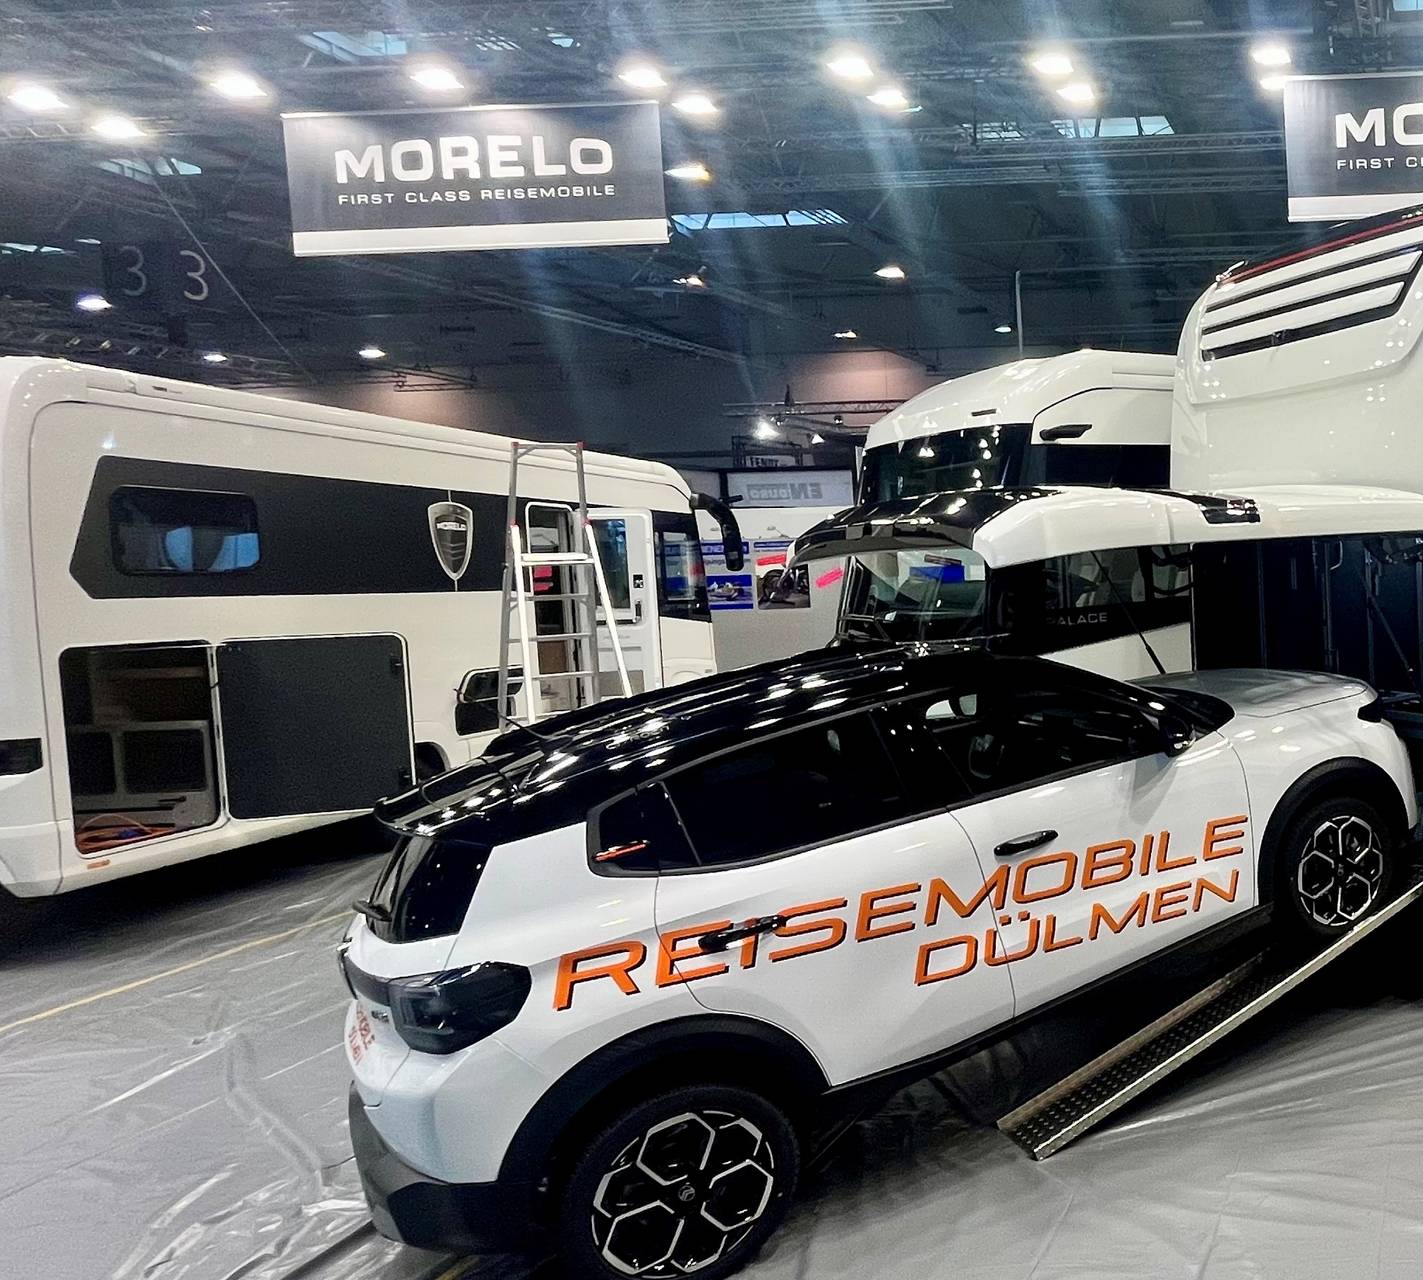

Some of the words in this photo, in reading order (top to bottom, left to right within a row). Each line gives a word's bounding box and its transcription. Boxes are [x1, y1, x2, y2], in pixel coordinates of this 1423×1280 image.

[334, 135, 614, 184] MORELO
[1337, 157, 1395, 170] FIRST
[338, 193, 395, 205] FIRST
[405, 190, 471, 203] CLASS
[480, 184, 616, 200] REISEMOBILE
[180, 249, 209, 301] 3
[553, 814, 1248, 1011] REISEMOBILE
[914, 868, 1240, 986] DÜLMEN
